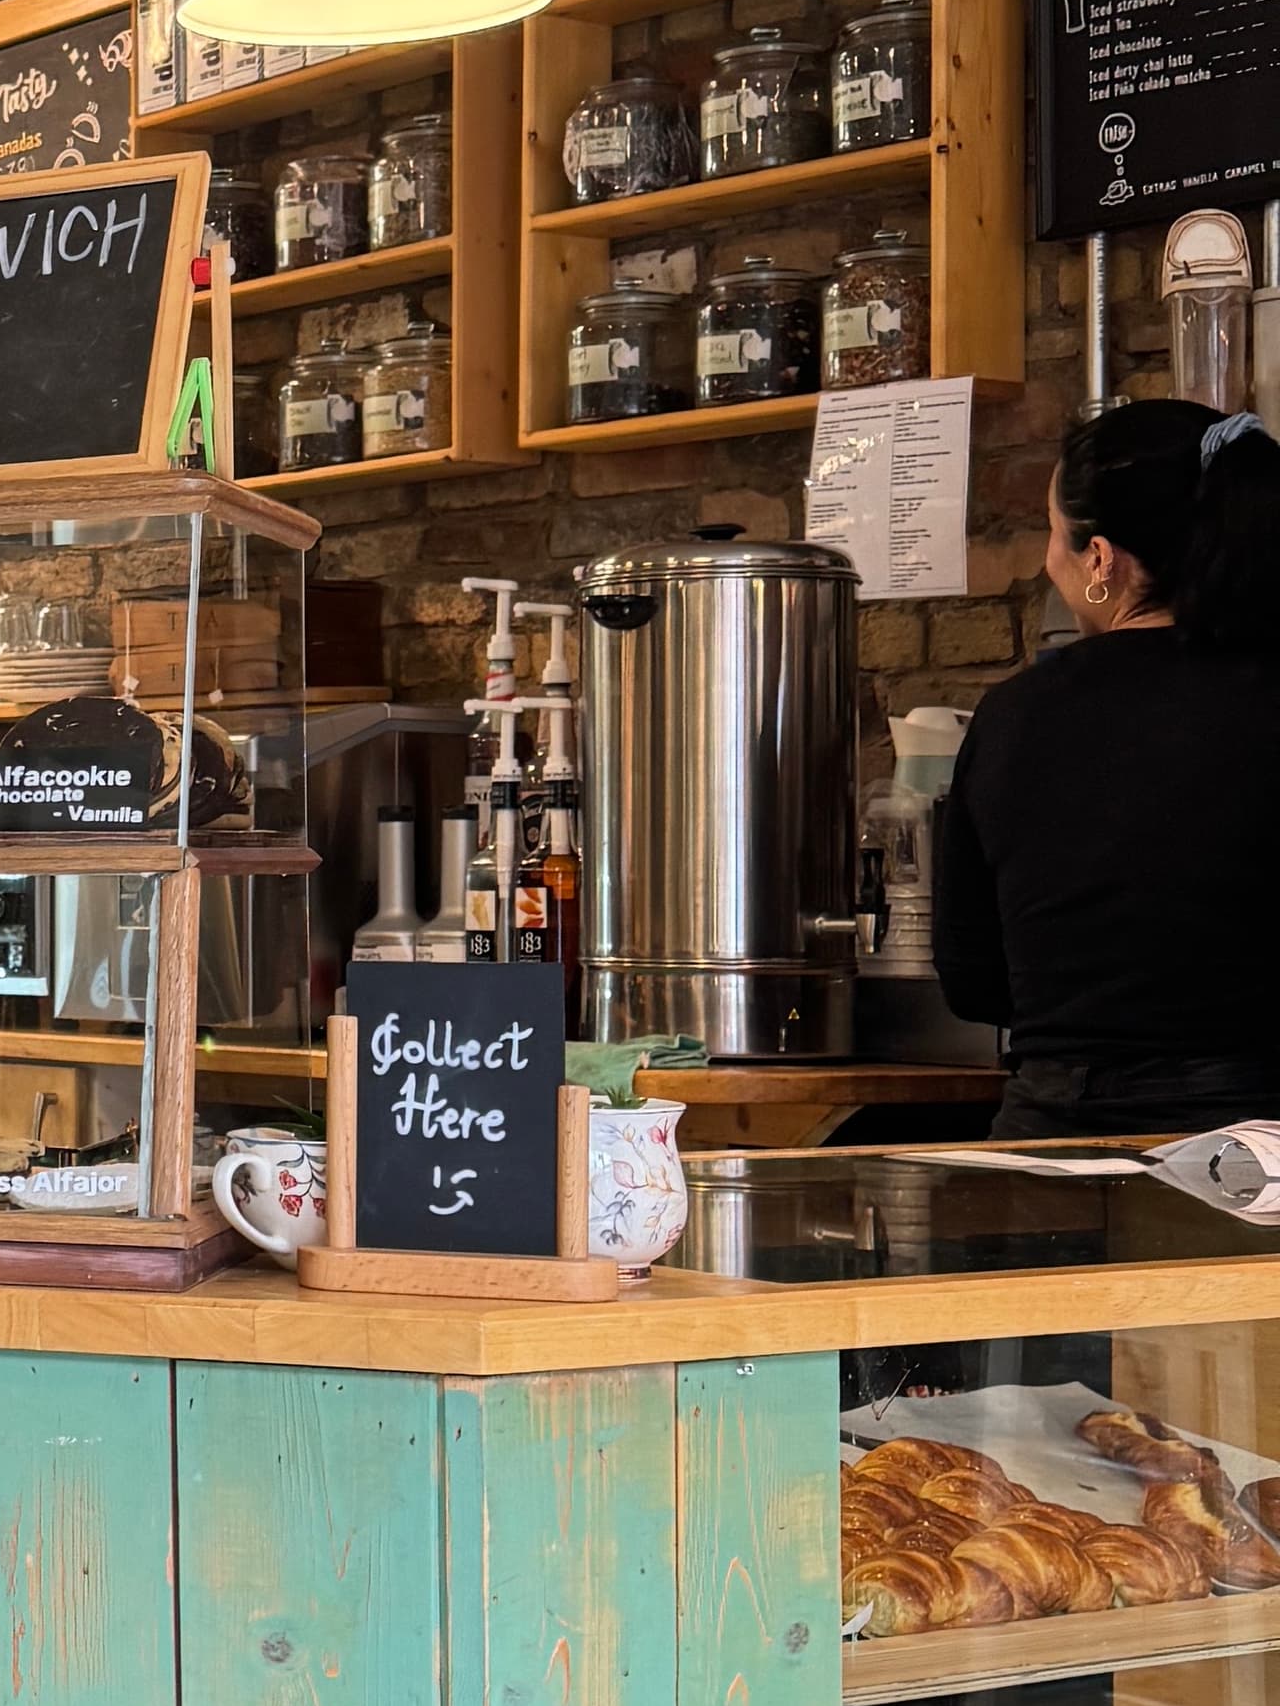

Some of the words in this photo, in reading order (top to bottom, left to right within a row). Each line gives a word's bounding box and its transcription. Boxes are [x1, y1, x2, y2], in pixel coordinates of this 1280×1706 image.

[1091, 2, 1112, 19] Iced
[1089, 20, 1111, 37] Iced
[1116, 18, 1132, 31] Tea
[1089, 44, 1110, 60] Iced
[1114, 37, 1162, 55] chocolate
[1089, 68, 1110, 84] Iced
[1089, 85, 1110, 102] Iced
[69, 806, 143, 823] Vainilla
[371, 1012, 534, 1076] Collect
[391, 1073, 506, 1142] Here
[32, 1167, 128, 1198] Alfajor
